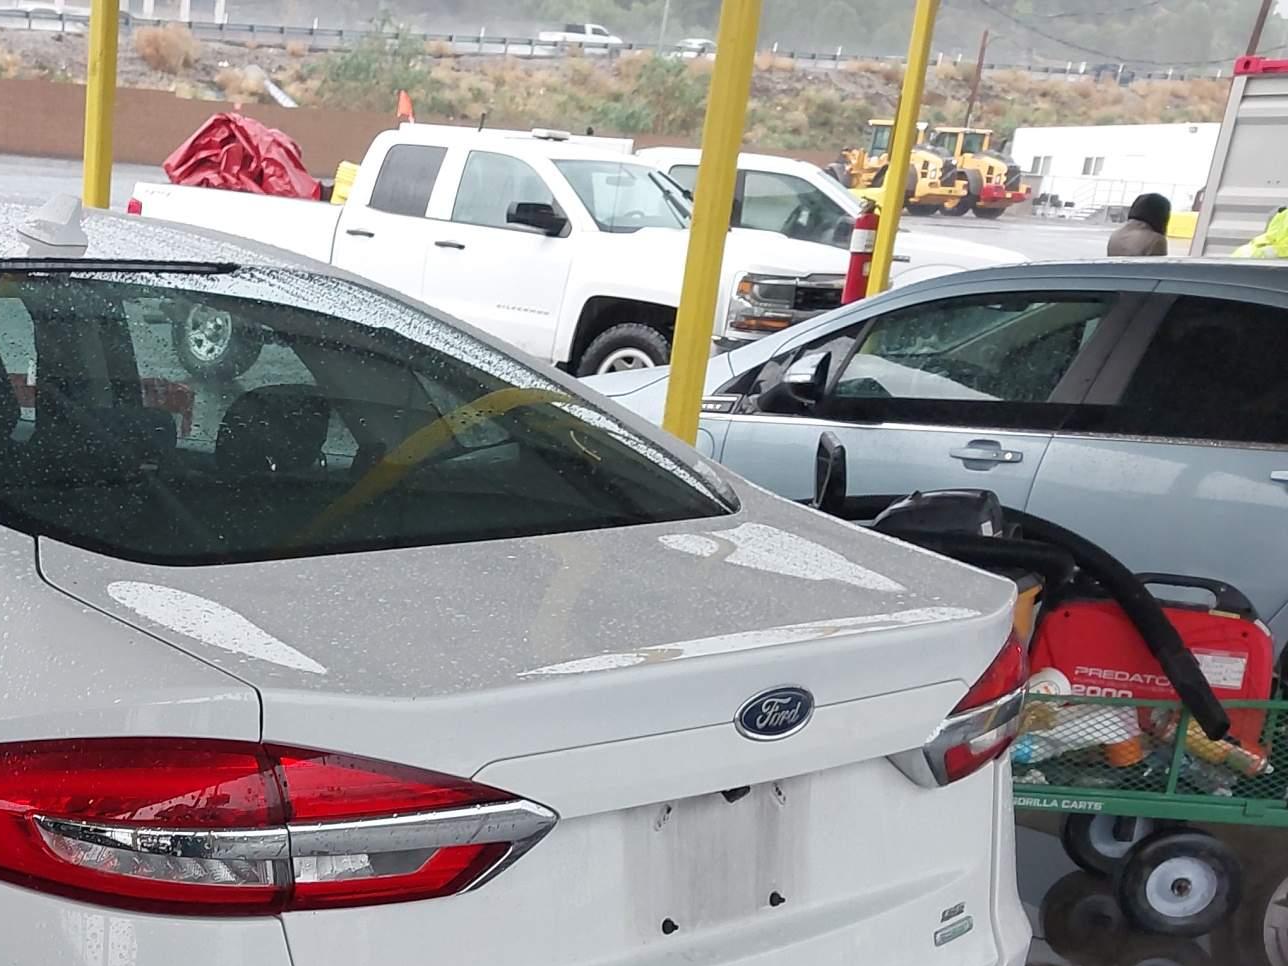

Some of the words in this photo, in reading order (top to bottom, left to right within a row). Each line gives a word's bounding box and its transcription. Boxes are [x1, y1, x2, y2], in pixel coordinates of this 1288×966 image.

[1074, 665, 1172, 687] PREDATO
[1071, 683, 1133, 698] 2000
[756, 696, 802, 729] Ford
[1061, 799, 1102, 811] CARTS
